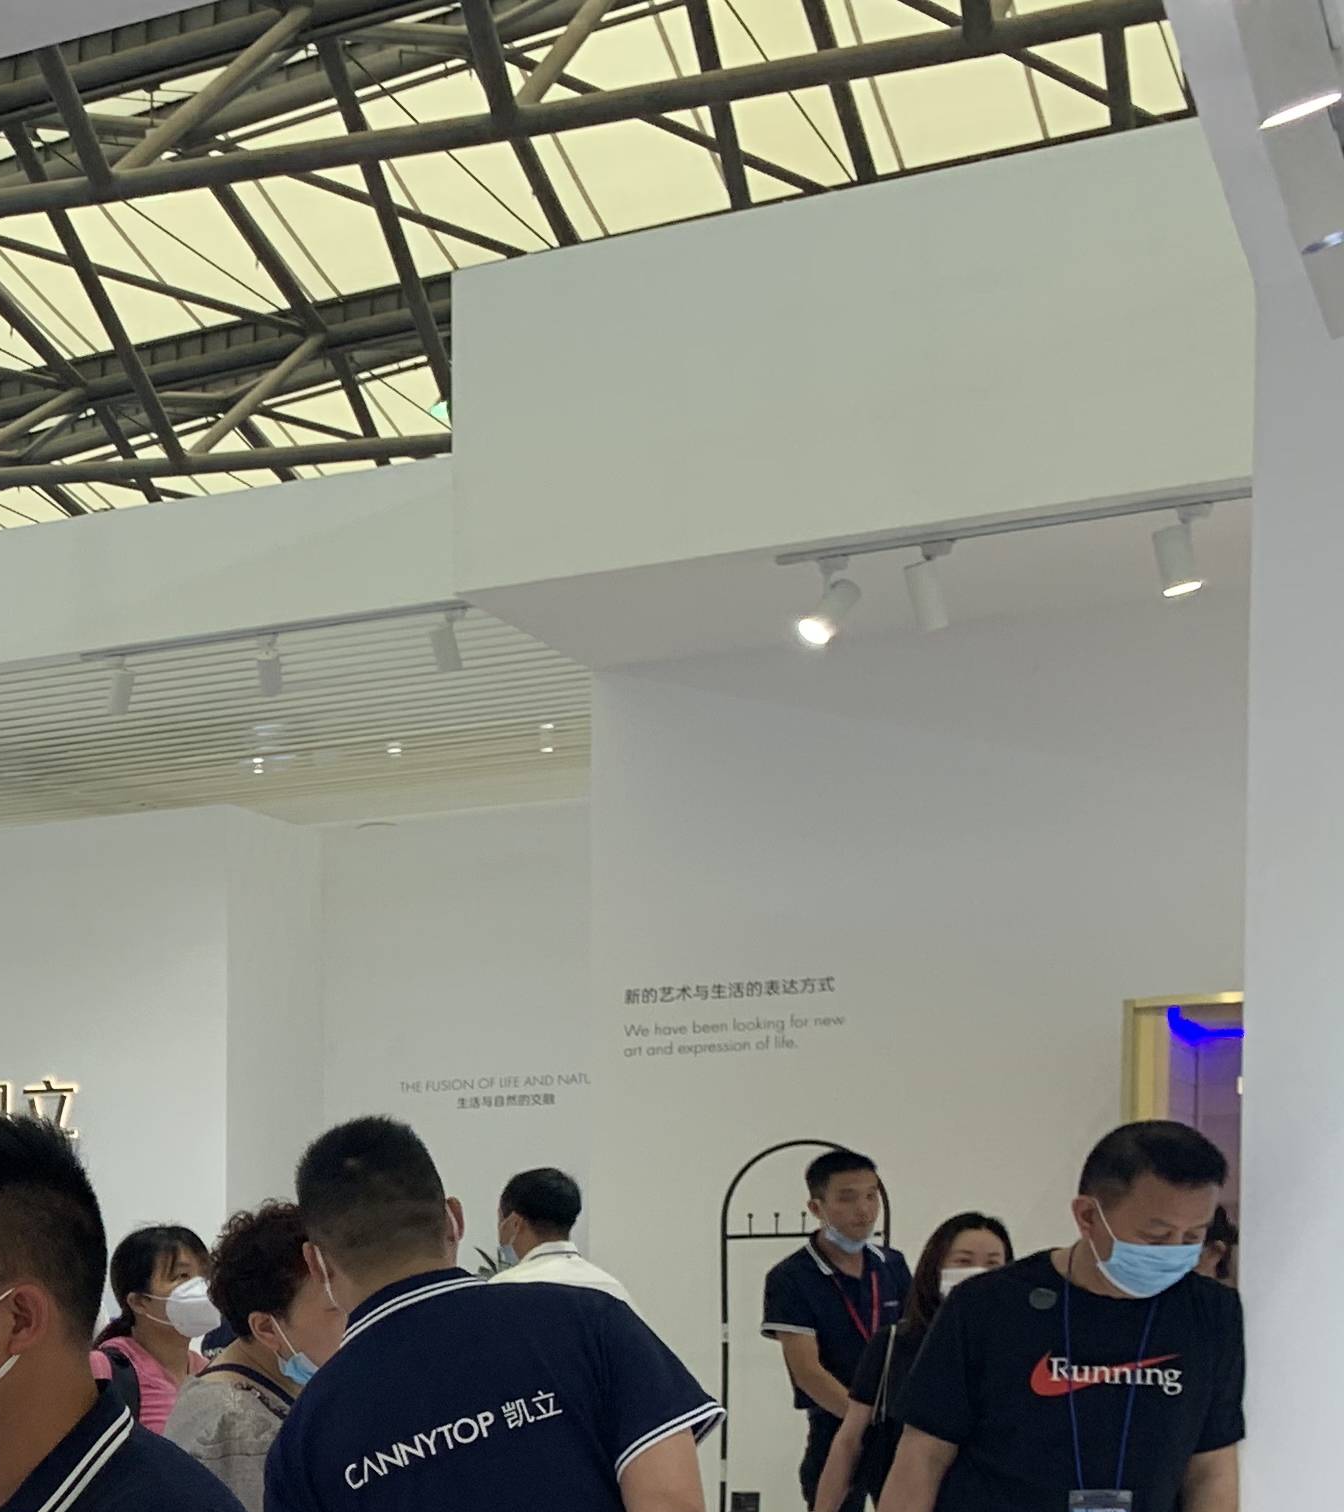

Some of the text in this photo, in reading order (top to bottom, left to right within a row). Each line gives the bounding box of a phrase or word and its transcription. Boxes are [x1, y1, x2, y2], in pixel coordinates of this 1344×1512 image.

[624, 976, 835, 1005] 新的艺术与生活的表达方式
[624, 1014, 846, 1037] We have been looking for new
[624, 1035, 798, 1058] art and expression of life.
[400, 1080, 422, 1093] THE
[425, 1078, 474, 1092] FUSION
[478, 1077, 495, 1089] OF
[499, 1076, 520, 1088] LIFE
[523, 1074, 554, 1087] AND
[1049, 1357, 1183, 1396] Running
[344, 1390, 563, 1490] CANNYTOP 凯立
